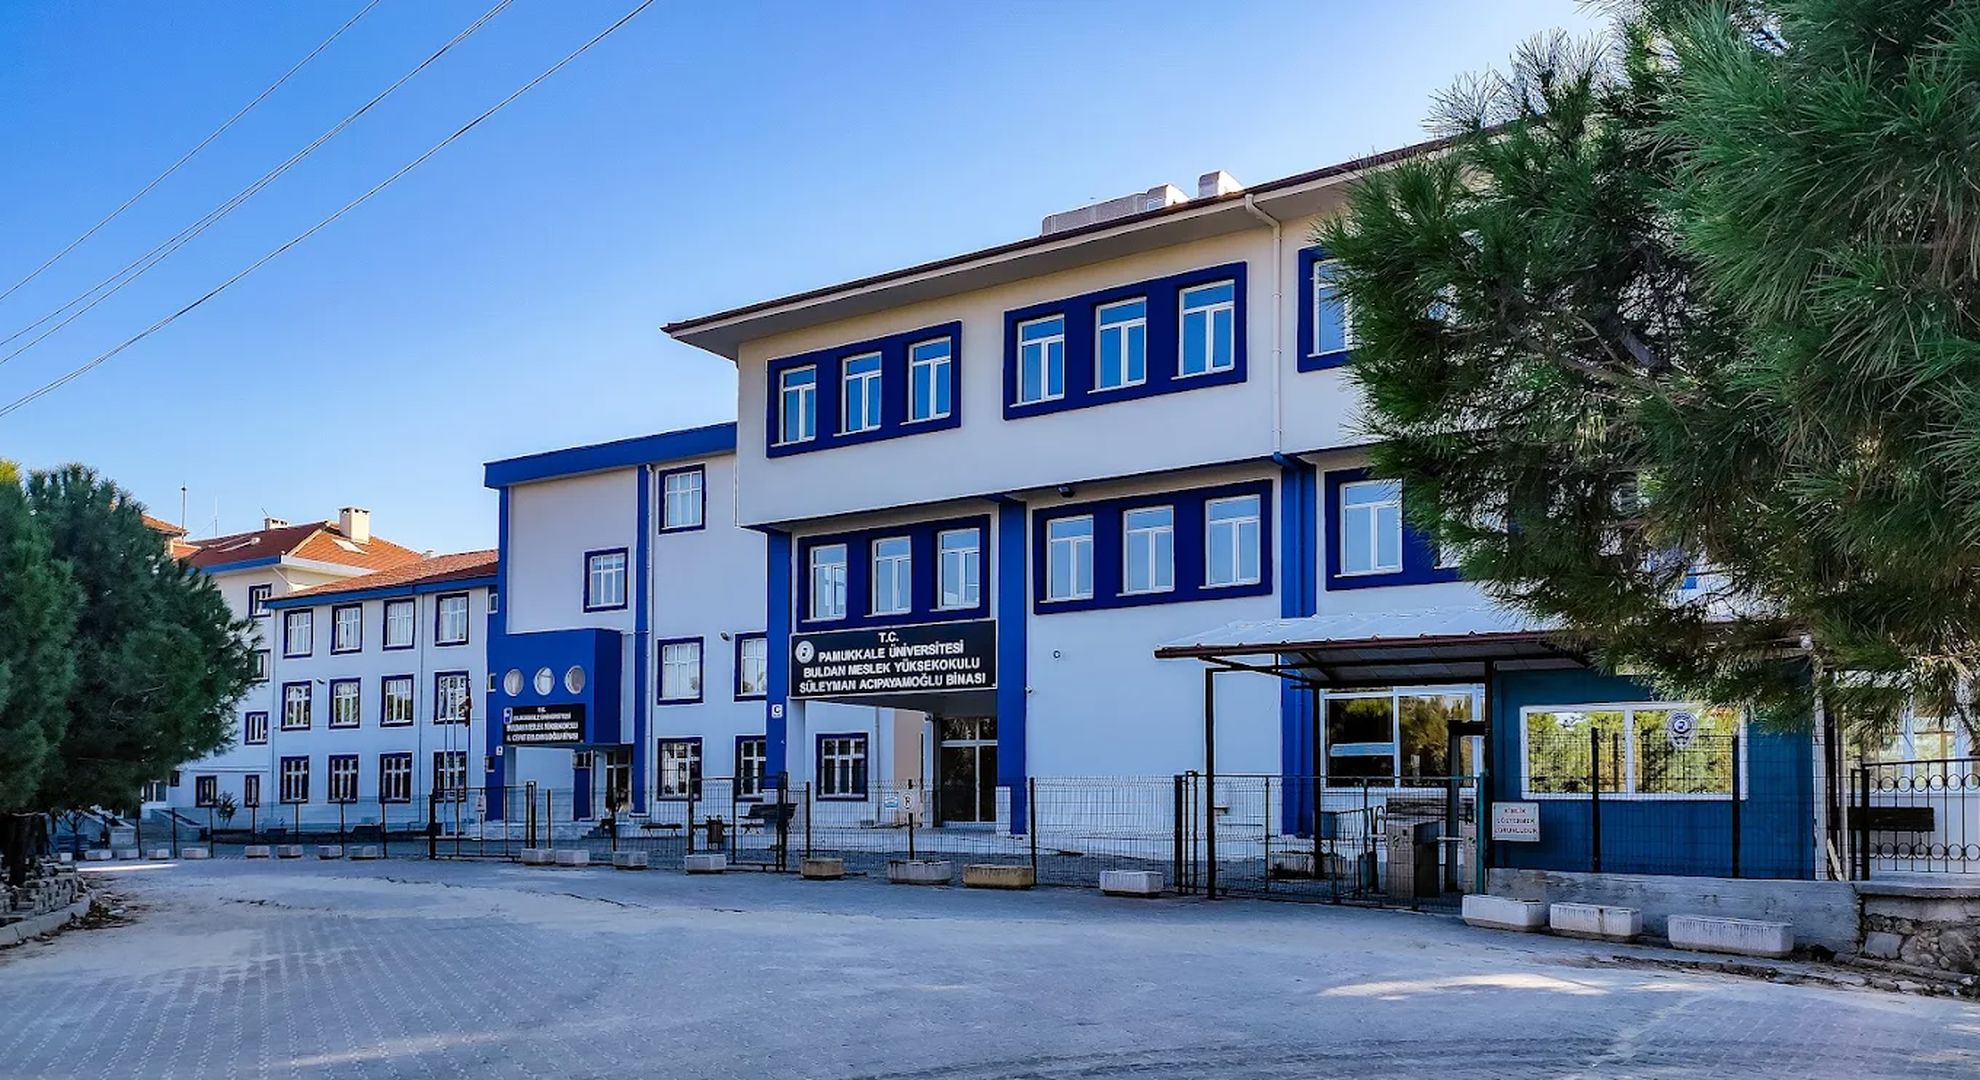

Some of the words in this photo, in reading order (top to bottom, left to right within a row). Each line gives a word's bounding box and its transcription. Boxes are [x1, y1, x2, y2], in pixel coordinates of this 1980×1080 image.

[878, 632, 899, 643] T.C.
[818, 648, 885, 663] PAMUKKALE
[889, 639, 964, 658] ÜNİVERSİTESİ
[803, 665, 845, 678] BULDAN
[848, 662, 891, 675] MESLEK
[894, 657, 980, 673] YÜKSEKOKULU
[799, 680, 857, 693] SÜLEYMAN
[859, 672, 943, 690] ACIPAYAMOĞLU
[946, 671, 986, 686] BİNASI
